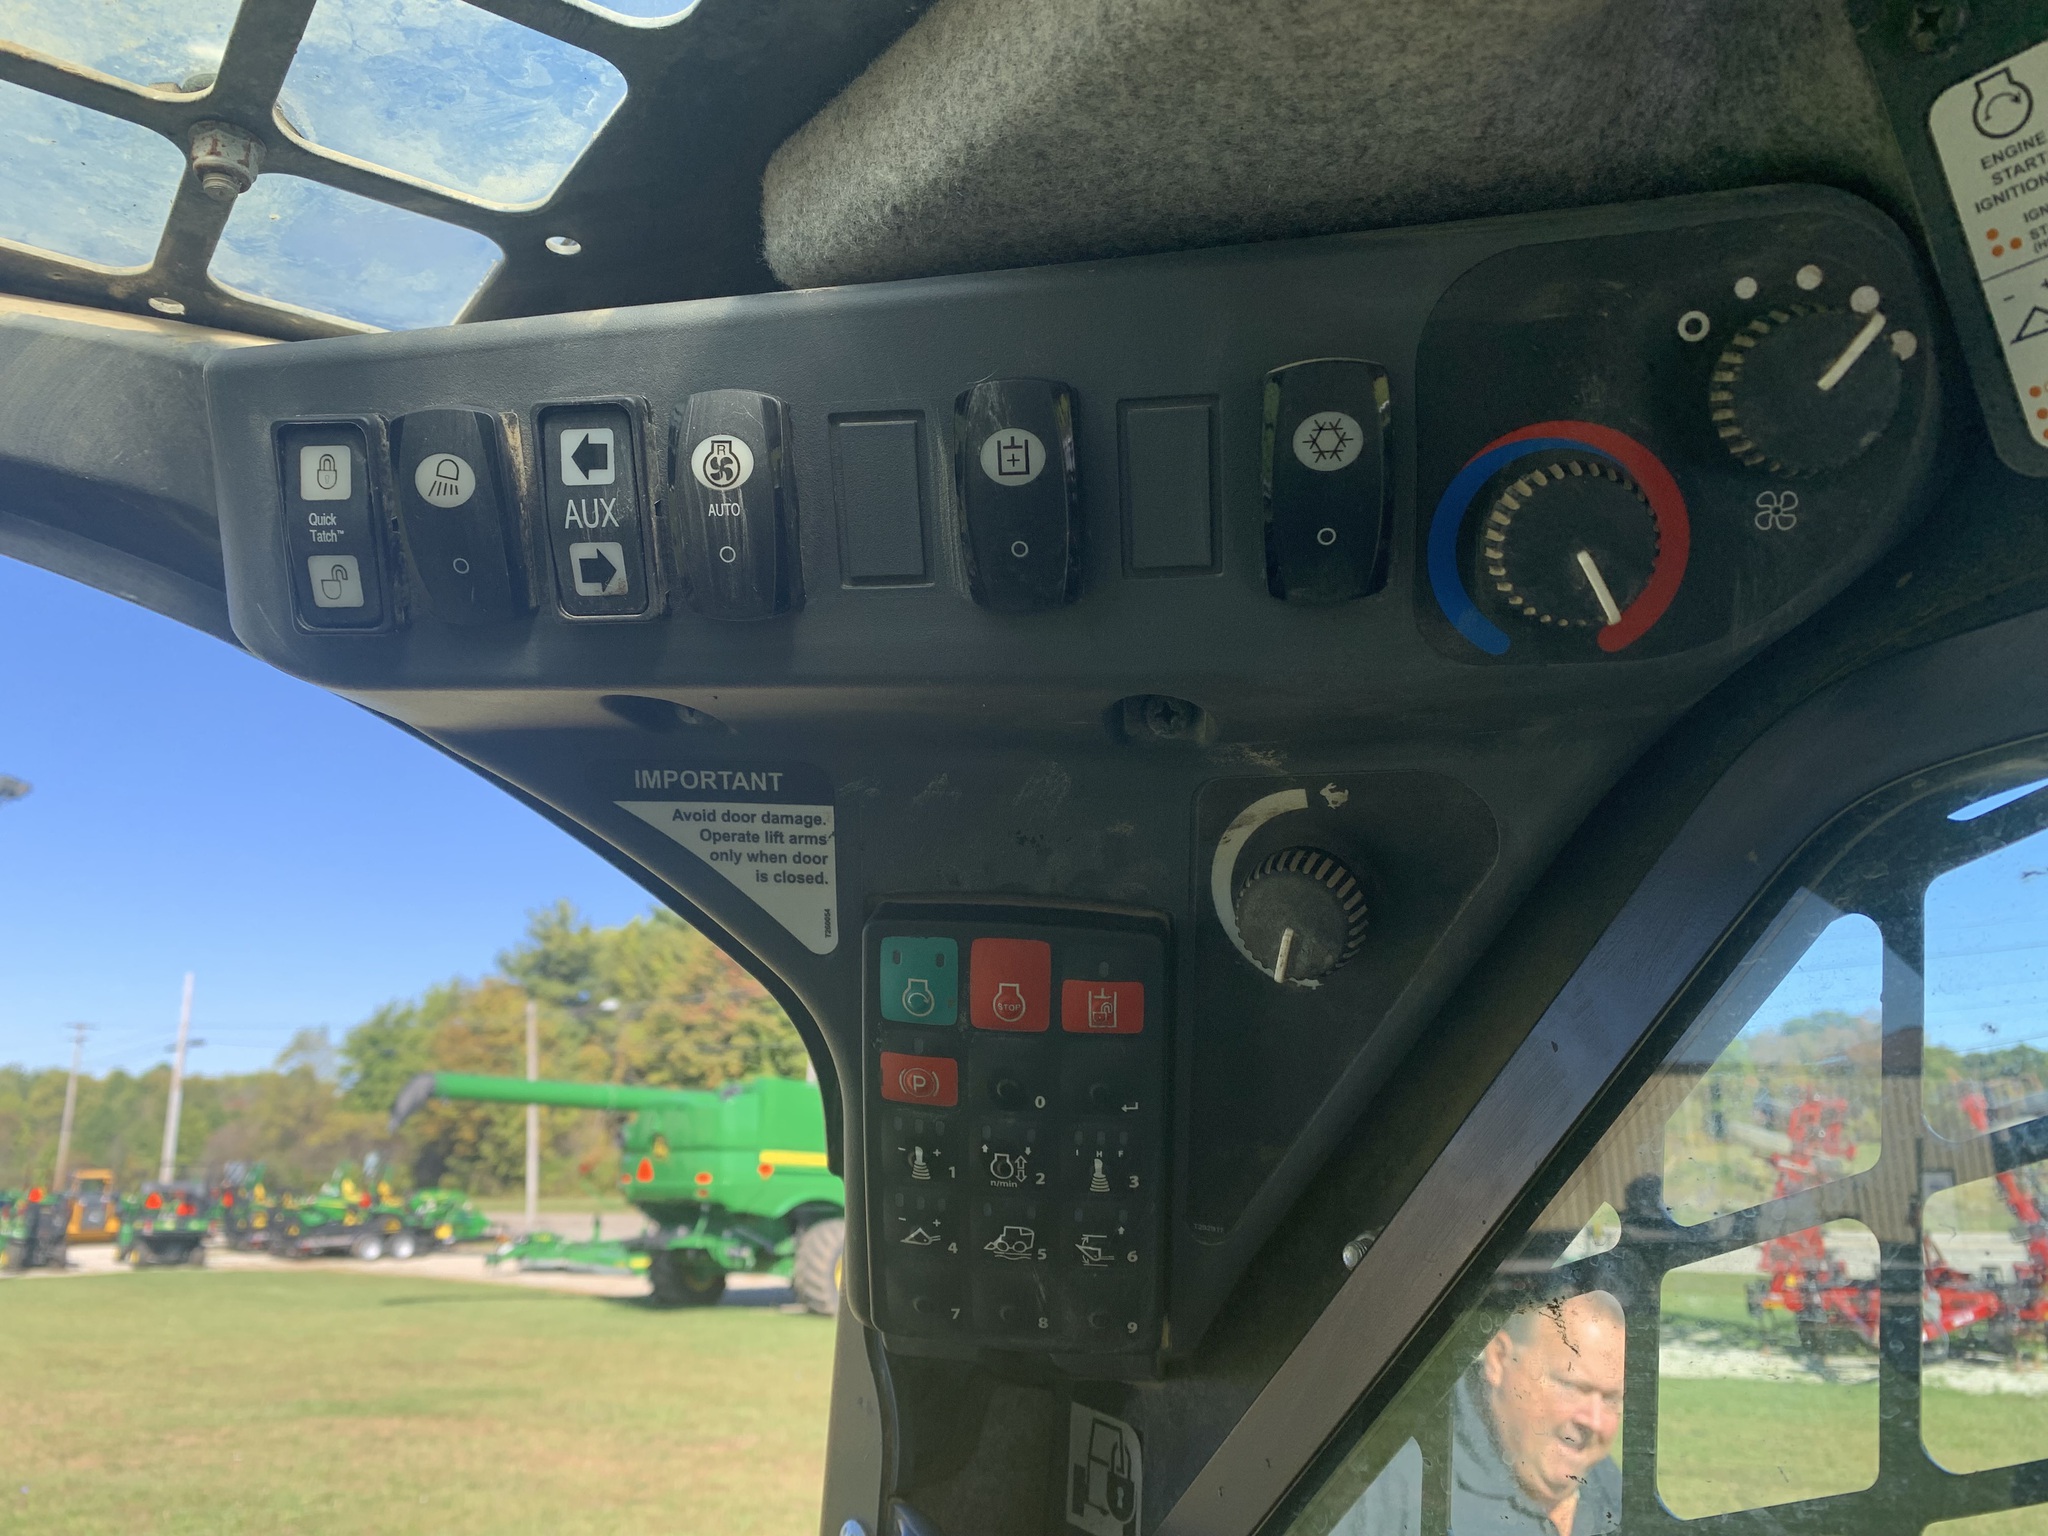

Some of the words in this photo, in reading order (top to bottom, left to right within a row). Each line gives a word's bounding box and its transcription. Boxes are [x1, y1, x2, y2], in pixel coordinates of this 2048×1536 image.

[1980, 130, 2046, 170] ENGINE
[1974, 171, 2048, 214] IGNITION
[564, 497, 620, 529] AUX
[708, 502, 741, 517] AUTO
[308, 512, 337, 526] Quick
[634, 769, 783, 792] IMPORTANT
[672, 808, 717, 823] Avoid
[721, 810, 757, 824] door
[761, 811, 827, 828] damage.
[700, 828, 760, 845] Operate
[765, 830, 784, 844] lift
[789, 833, 827, 846] arms
[709, 849, 742, 866] only
[746, 851, 788, 864] when
[792, 852, 829, 865] door
[755, 870, 769, 883] is
[773, 870, 829, 885] closed.
[997, 1002, 1021, 1012] STOP
[913, 1074, 926, 1092] P
[949, 1166, 956, 1179] 1
[1035, 1172, 1046, 1185] 2
[990, 1179, 1018, 1188] n/min
[1129, 1175, 1140, 1189] 3
[948, 1242, 958, 1254] 4
[1037, 1249, 1048, 1261] 5
[1127, 1251, 1138, 1263] 6
[950, 1308, 961, 1320] 7
[1038, 1317, 1049, 1330] 8
[1127, 1322, 1138, 1334] 9
